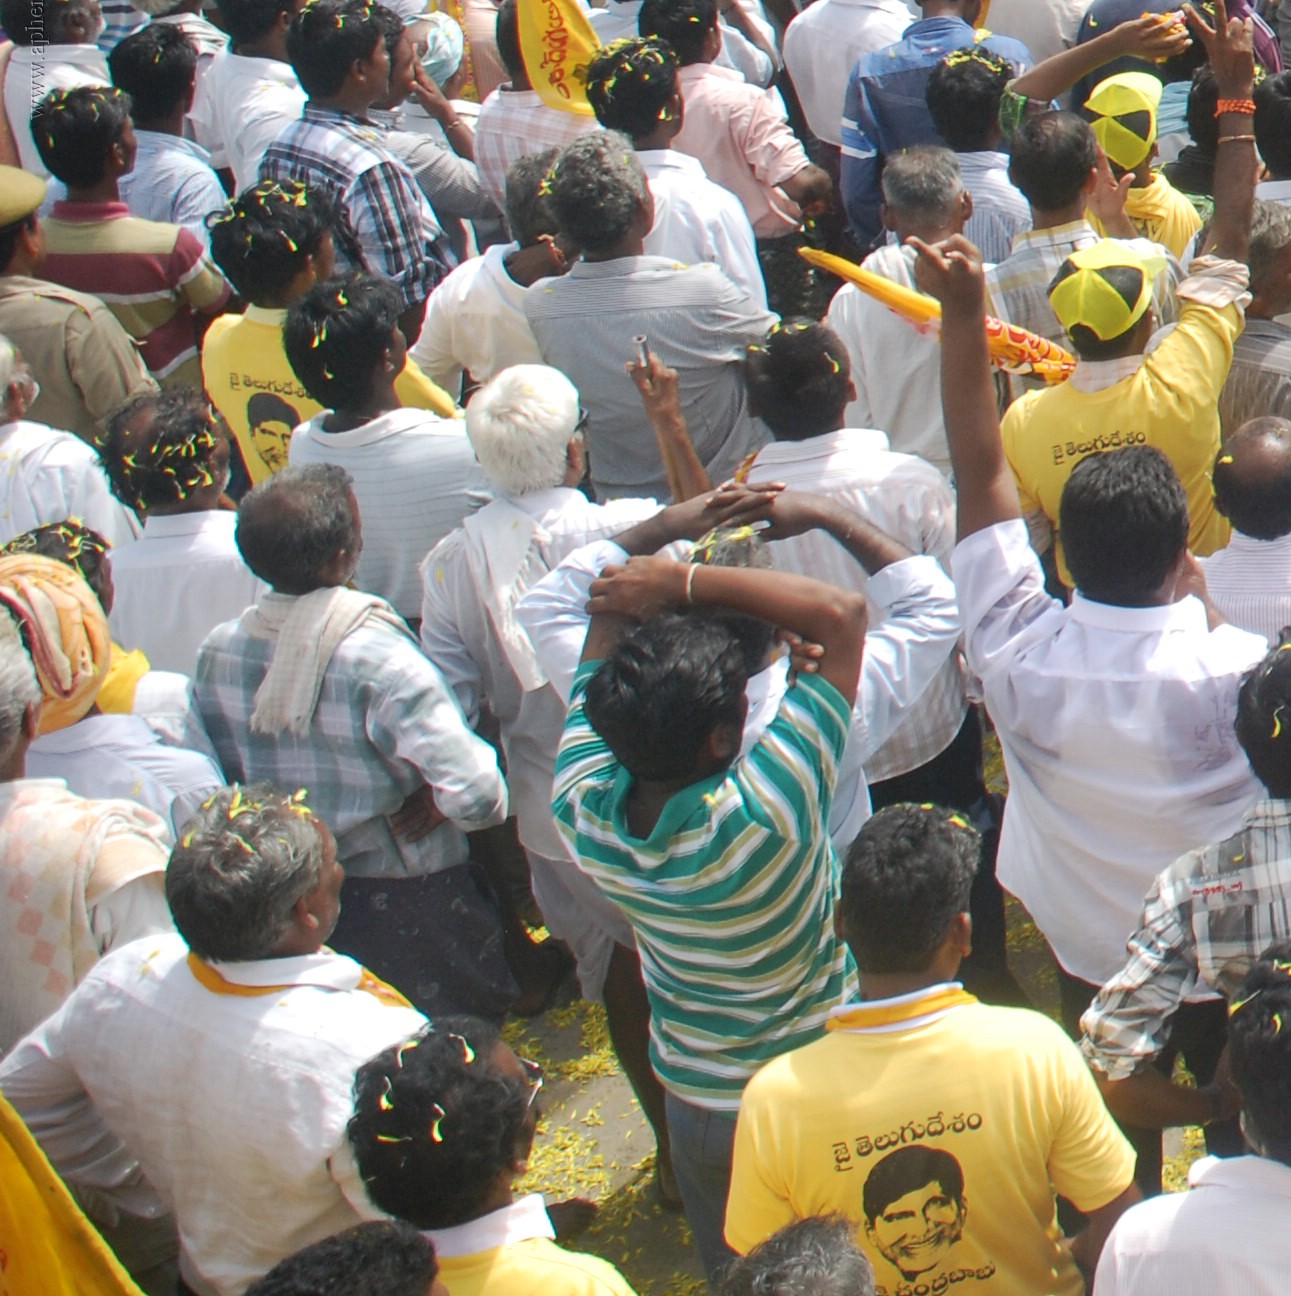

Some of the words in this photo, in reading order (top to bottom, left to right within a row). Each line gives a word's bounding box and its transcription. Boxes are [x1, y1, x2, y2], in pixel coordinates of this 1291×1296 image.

[1066, 430, 1146, 456] తెలుగుదేశం
[832, 1142, 853, 1172] జై
[856, 1111, 982, 1157] తెలుగుదేశం
